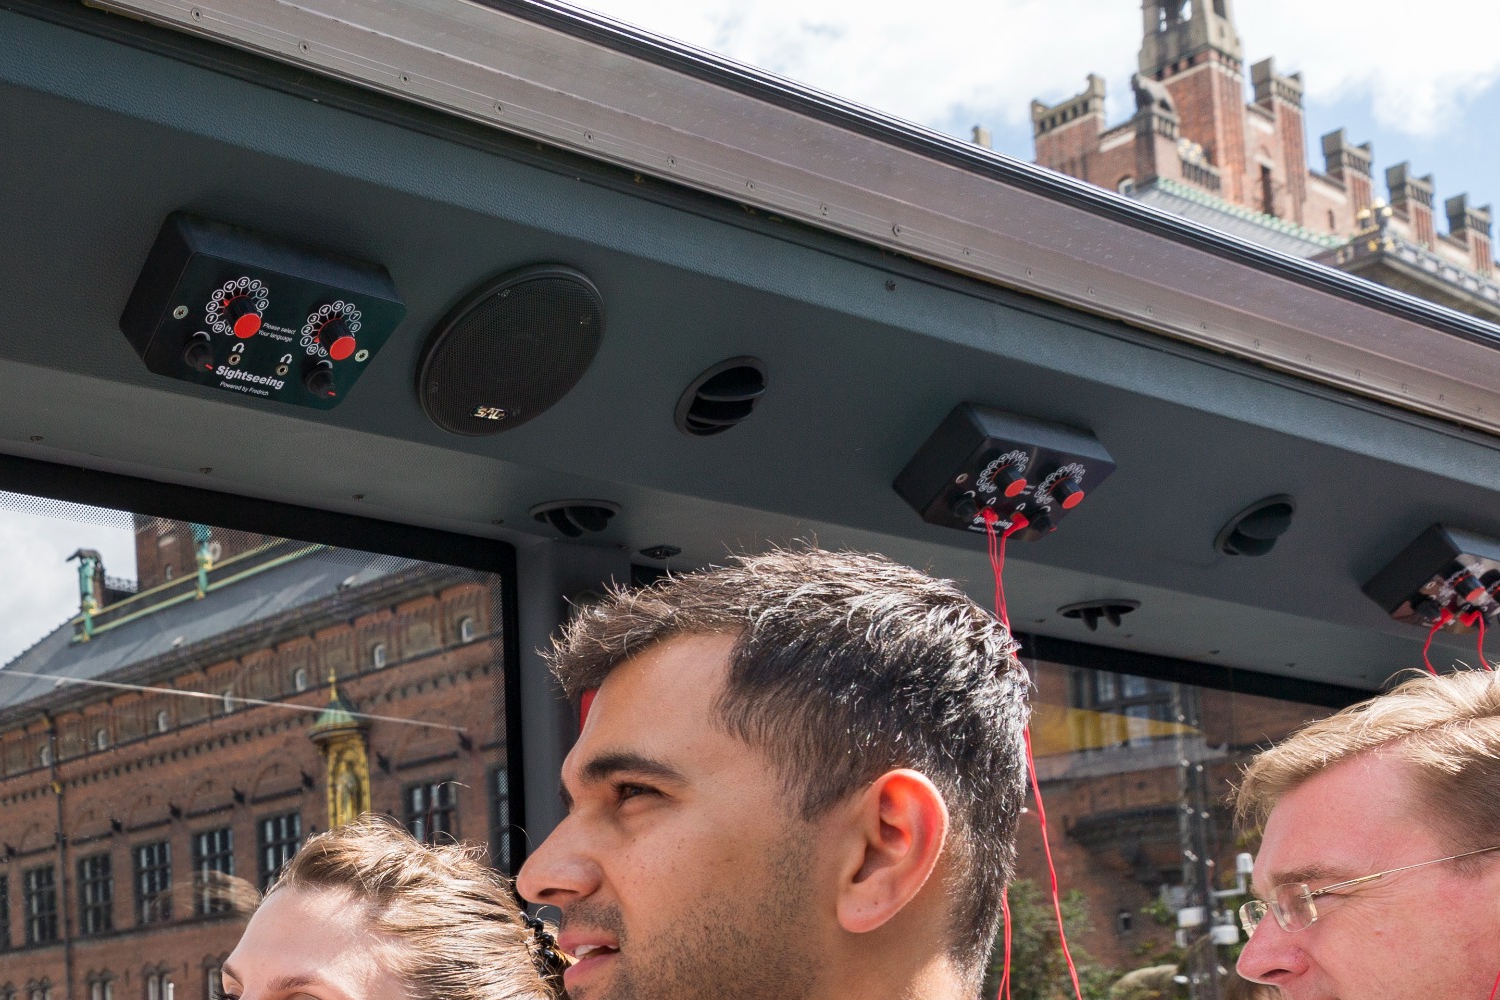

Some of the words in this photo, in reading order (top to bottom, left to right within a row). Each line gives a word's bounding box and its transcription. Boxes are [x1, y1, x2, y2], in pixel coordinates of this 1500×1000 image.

[262, 322, 280, 331] Please
[281, 327, 297, 336] select
[270, 332, 293, 343] language
[216, 365, 285, 390] Sightseeing
[220, 381, 242, 391] Powered
[249, 387, 270, 396] Fredrich
